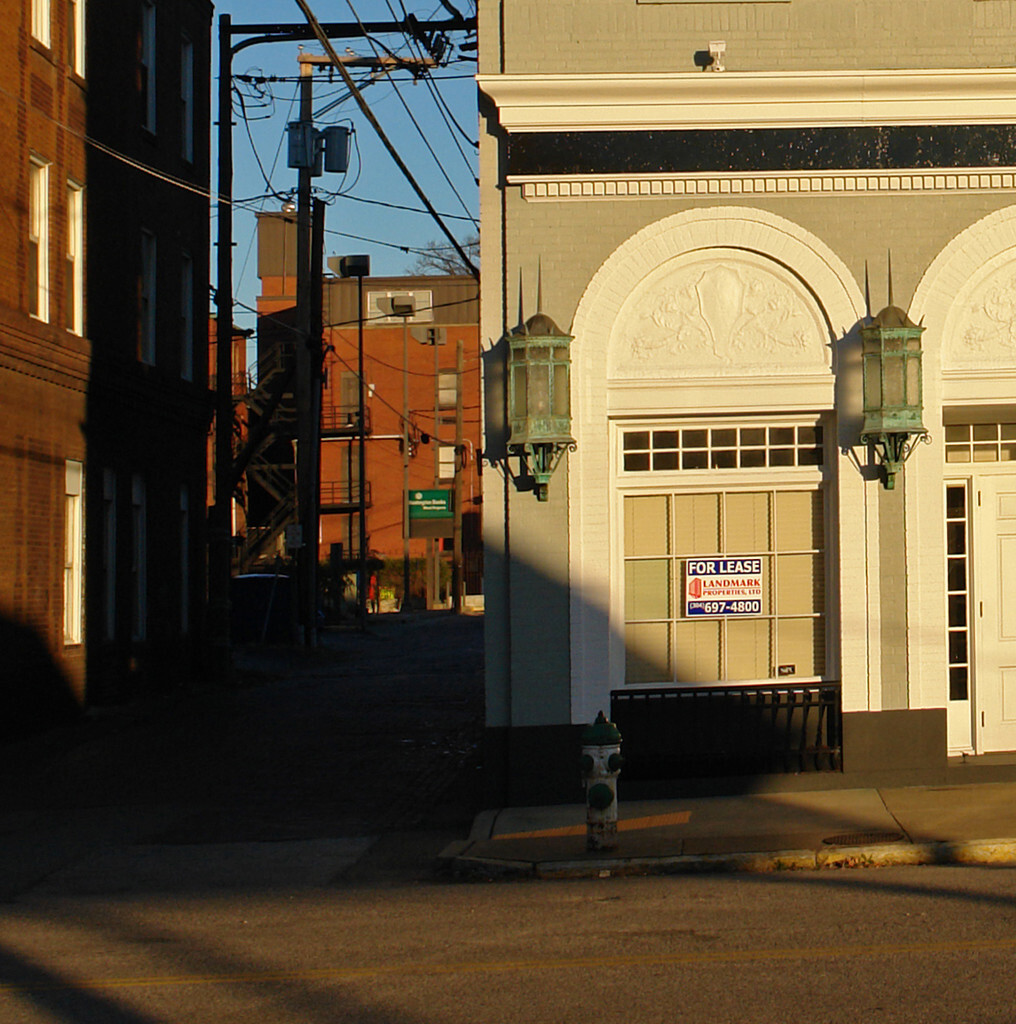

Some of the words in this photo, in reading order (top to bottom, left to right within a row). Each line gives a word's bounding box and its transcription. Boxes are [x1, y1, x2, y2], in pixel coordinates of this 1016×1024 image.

[689, 561, 716, 574] FOR
[720, 560, 760, 573] LEASE
[703, 579, 760, 588] LANDMARK
